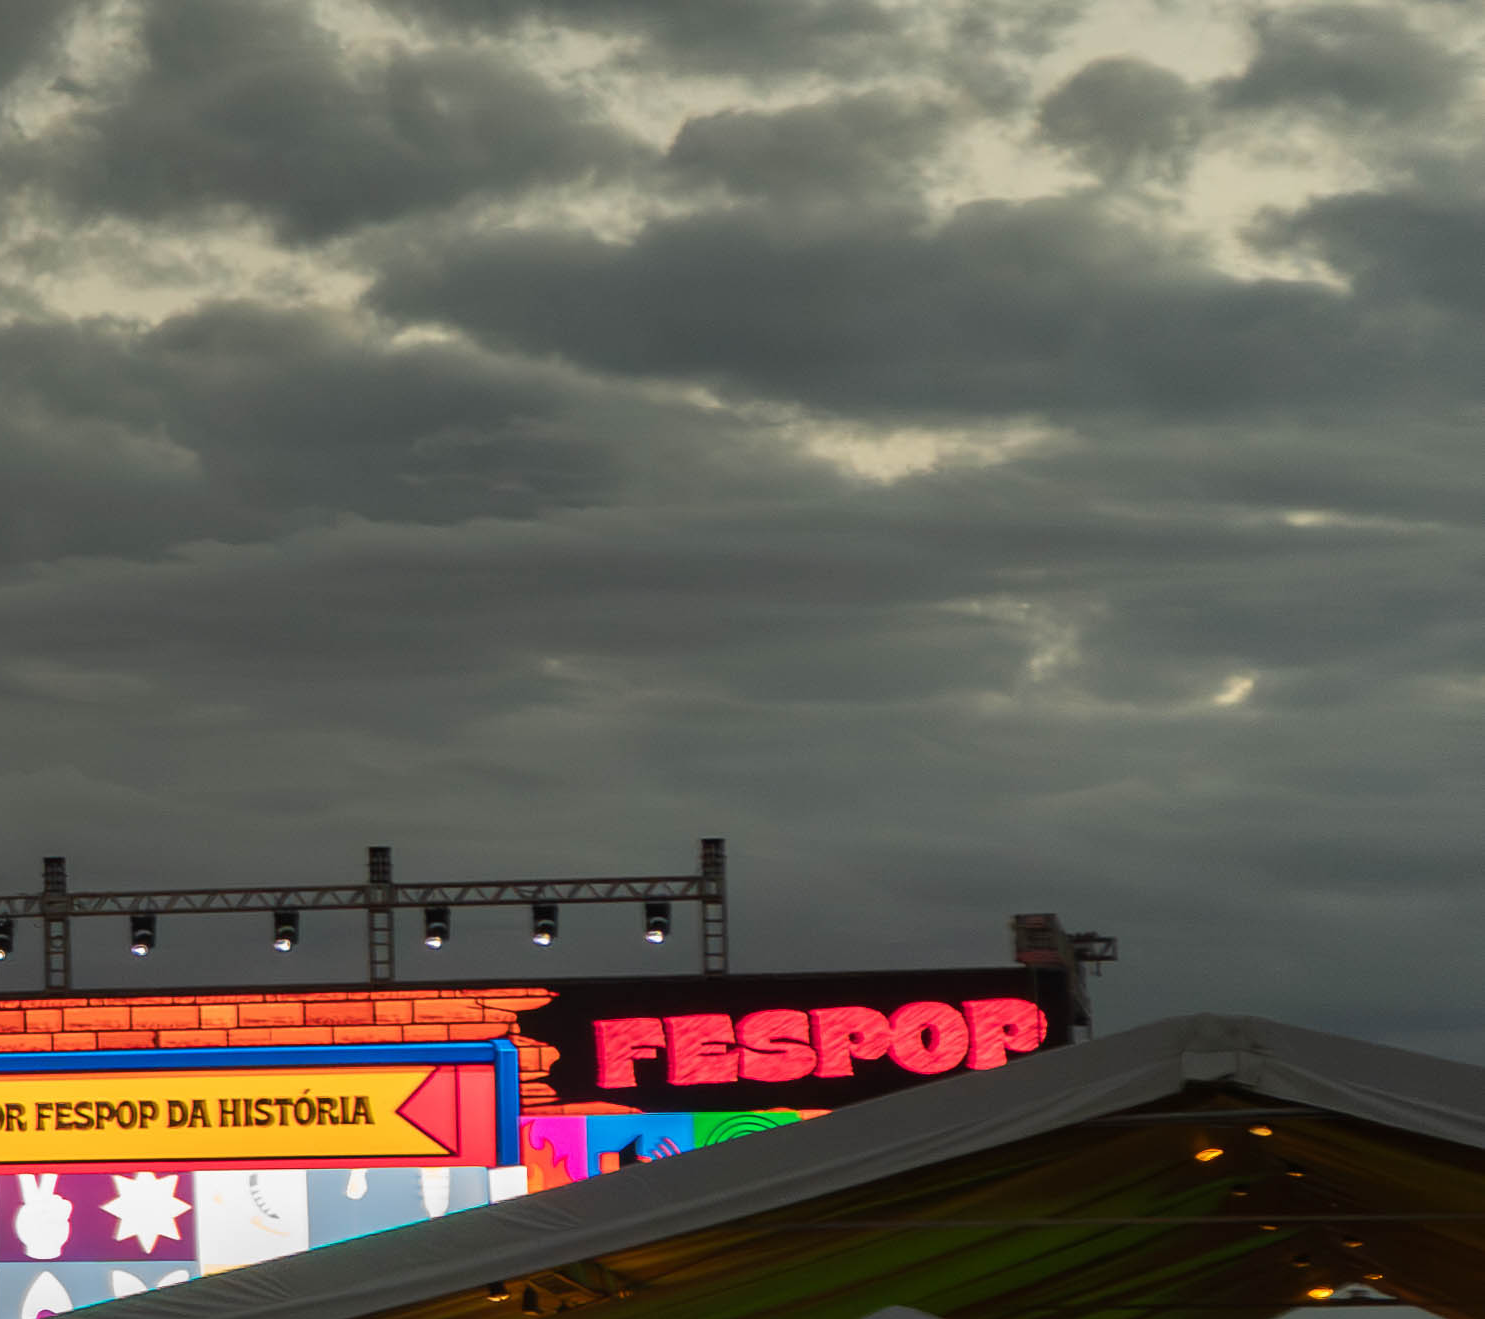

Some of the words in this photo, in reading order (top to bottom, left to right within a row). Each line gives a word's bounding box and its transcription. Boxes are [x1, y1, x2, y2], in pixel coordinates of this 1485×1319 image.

[593, 997, 1048, 1090] FESPOP
[35, 1100, 158, 1132] FESPOP
[166, 1098, 212, 1129] DA
[219, 1088, 375, 1128] HISTÓRIA
